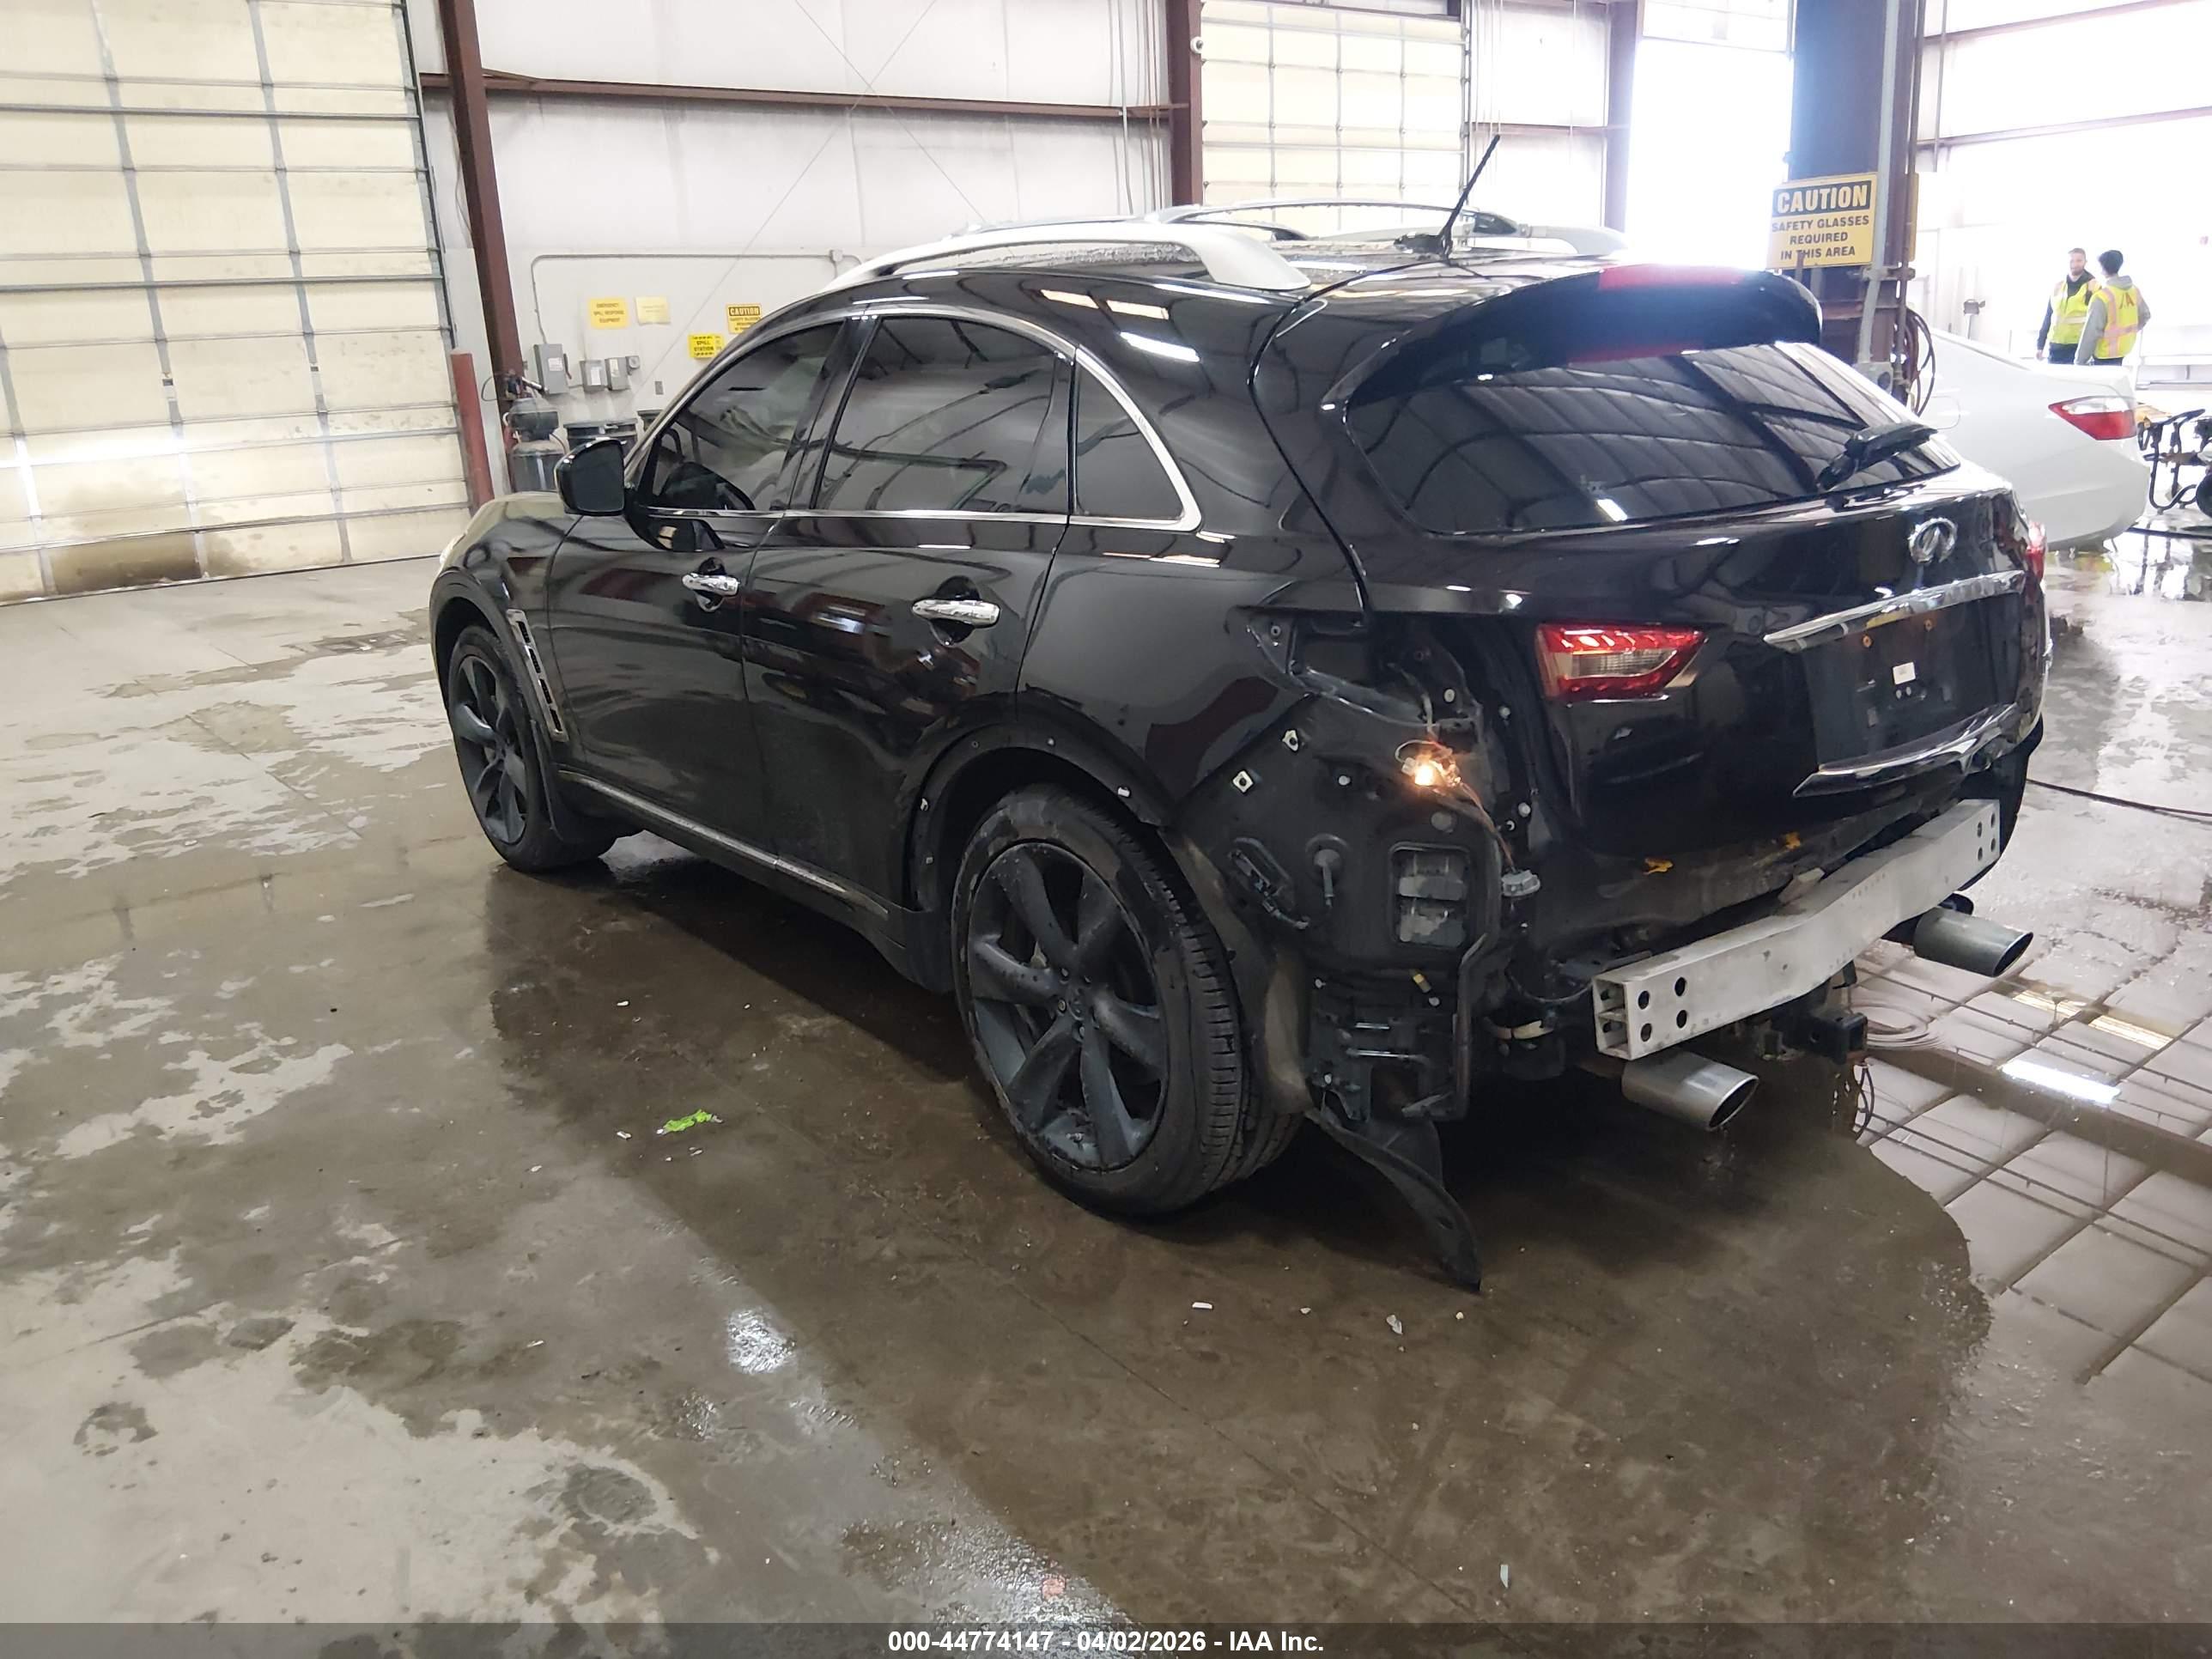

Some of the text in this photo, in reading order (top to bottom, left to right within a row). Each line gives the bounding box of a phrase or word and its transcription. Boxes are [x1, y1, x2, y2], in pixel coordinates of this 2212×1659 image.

[1777, 185, 1869, 214] CAUTION
[1771, 215, 1869, 233] SAFETY GLASSES
[1790, 232, 1849, 246] REQUIRED
[1780, 246, 1856, 260] IN THIS AREA
[729, 307, 759, 316] CAUTION
